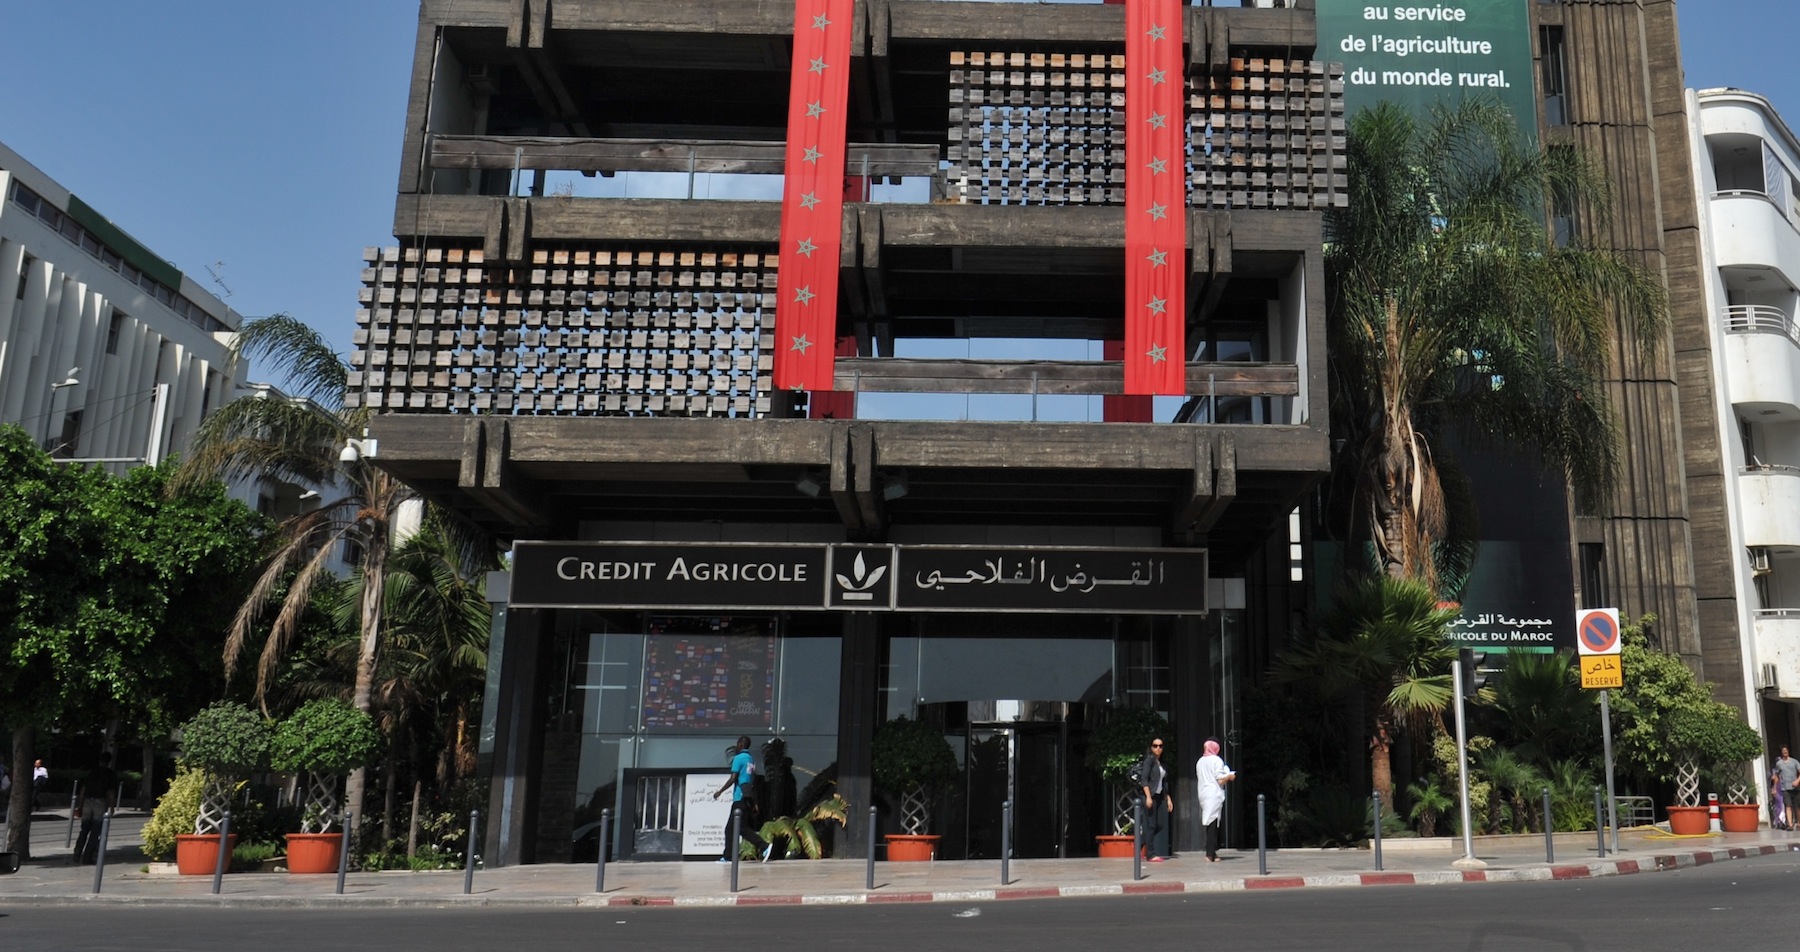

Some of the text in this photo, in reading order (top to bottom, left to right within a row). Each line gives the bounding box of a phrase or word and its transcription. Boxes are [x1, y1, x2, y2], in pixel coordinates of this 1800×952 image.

[1363, 4, 1466, 21] au service
[1340, 35, 1366, 52] de
[1350, 67, 1376, 85] du
[1382, 68, 1452, 86] monde
[1458, 70, 1511, 88] rural.
[556, 556, 807, 582] CREDIT AGRICOLE
[1446, 613, 1553, 629] مجموعة القرض
[1491, 632, 1508, 641] DU
[1510, 630, 1554, 641] MAROC
[1586, 658, 1616, 675] خاص
[1585, 676, 1619, 686] RESERVE
